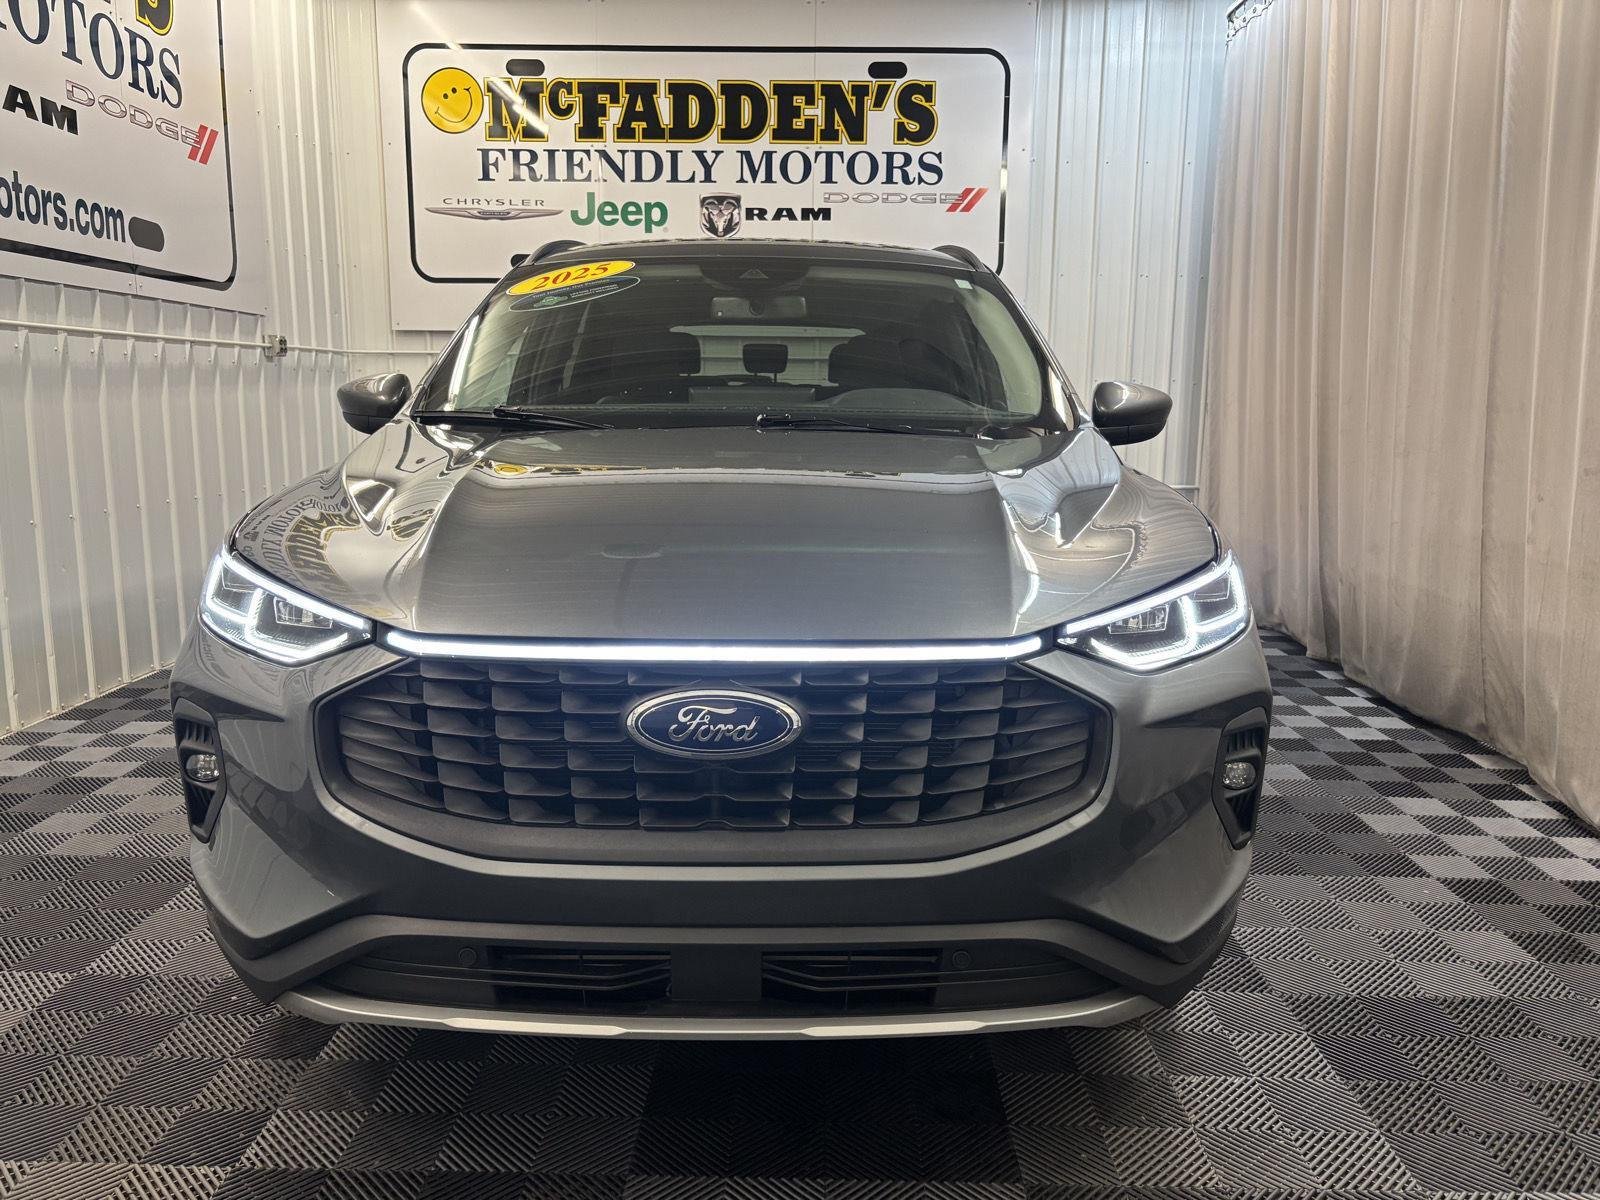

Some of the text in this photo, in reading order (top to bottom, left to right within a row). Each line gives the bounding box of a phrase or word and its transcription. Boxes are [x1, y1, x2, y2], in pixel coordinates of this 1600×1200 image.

[0, 0, 182, 109] OTORS
[65, 79, 202, 150] DODGE
[477, 147, 943, 186] FRIENDLY MOTORS
[442, 197, 545, 208] CHRYSLER
[570, 192, 668, 233] Jeep
[745, 207, 832, 221] RAM
[823, 191, 965, 204] DODGE
[530, 263, 612, 291] 2025
[668, 705, 761, 742] Ford
